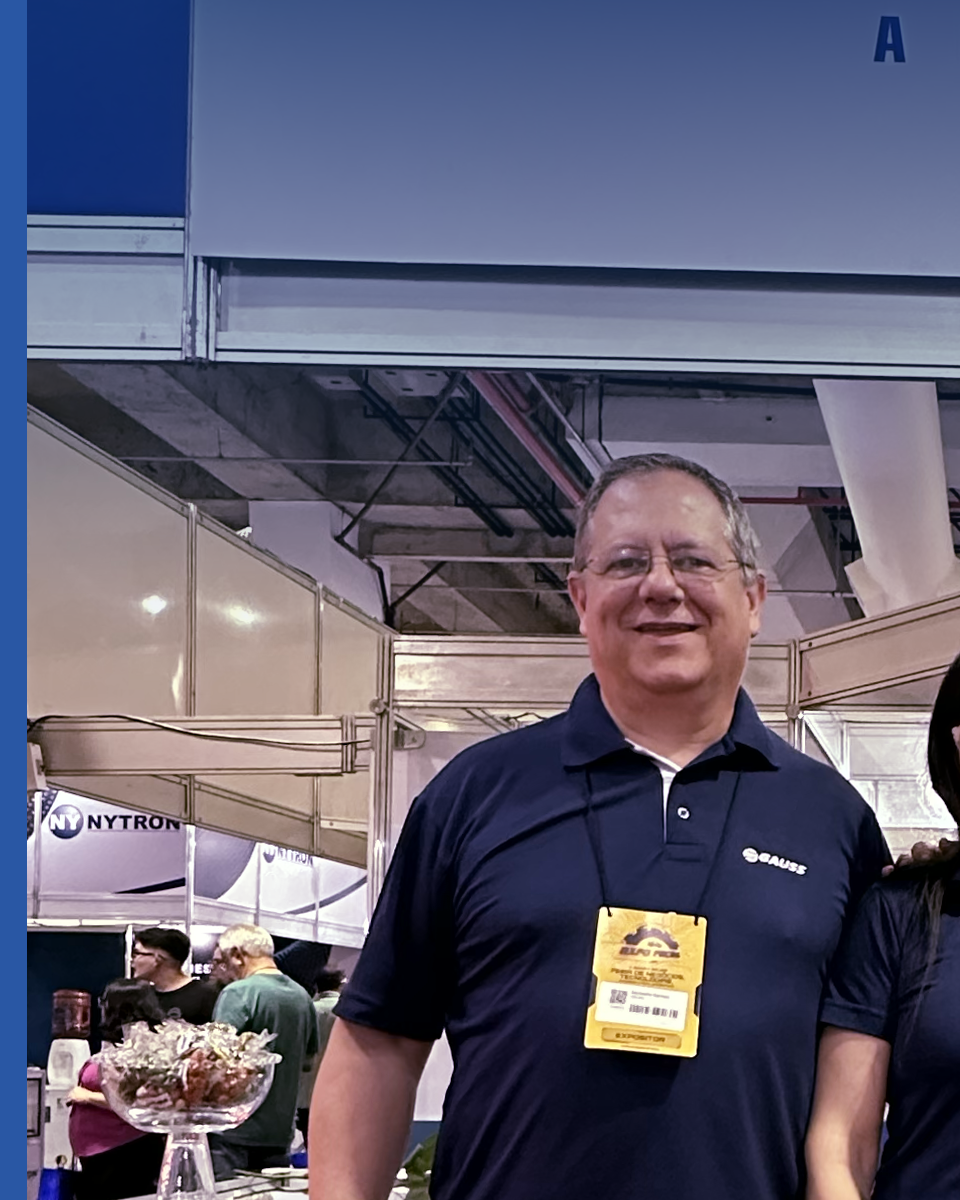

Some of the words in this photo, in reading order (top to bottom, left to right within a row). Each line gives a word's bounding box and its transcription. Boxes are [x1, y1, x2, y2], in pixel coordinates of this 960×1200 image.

[873, 16, 907, 63] A
[50, 814, 80, 830] NY
[88, 815, 180, 830] NYTRON
[758, 853, 808, 876] GAUSS
